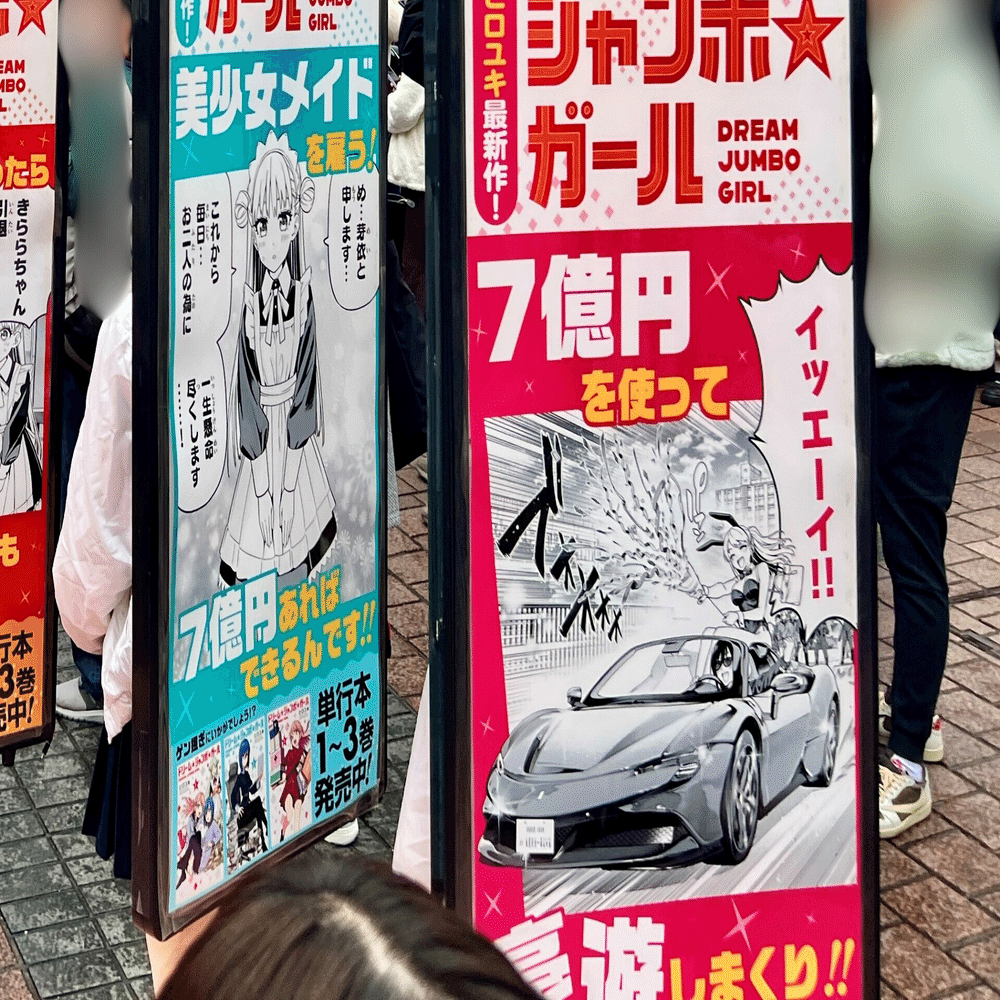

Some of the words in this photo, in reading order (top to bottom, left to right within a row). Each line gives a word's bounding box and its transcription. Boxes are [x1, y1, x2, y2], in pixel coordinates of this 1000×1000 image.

[308, 12, 338, 31] GIRL
[175, 57, 374, 141] 美少女メイド
[717, 118, 799, 142] DREAM
[527, 101, 704, 209] ガール
[717, 148, 801, 172] JUMBO
[717, 180, 772, 204] GIRL
[13, 198, 30, 317] きららちゃん
[182, 206, 192, 336] お二人の為に
[210, 200, 221, 285] これから
[477, 250, 691, 363] 7億円
[581, 365, 730, 424] を使って
[186, 378, 200, 488] 尽くします
[317, 671, 372, 727] 単行本
[314, 752, 372, 818] 発売中!
